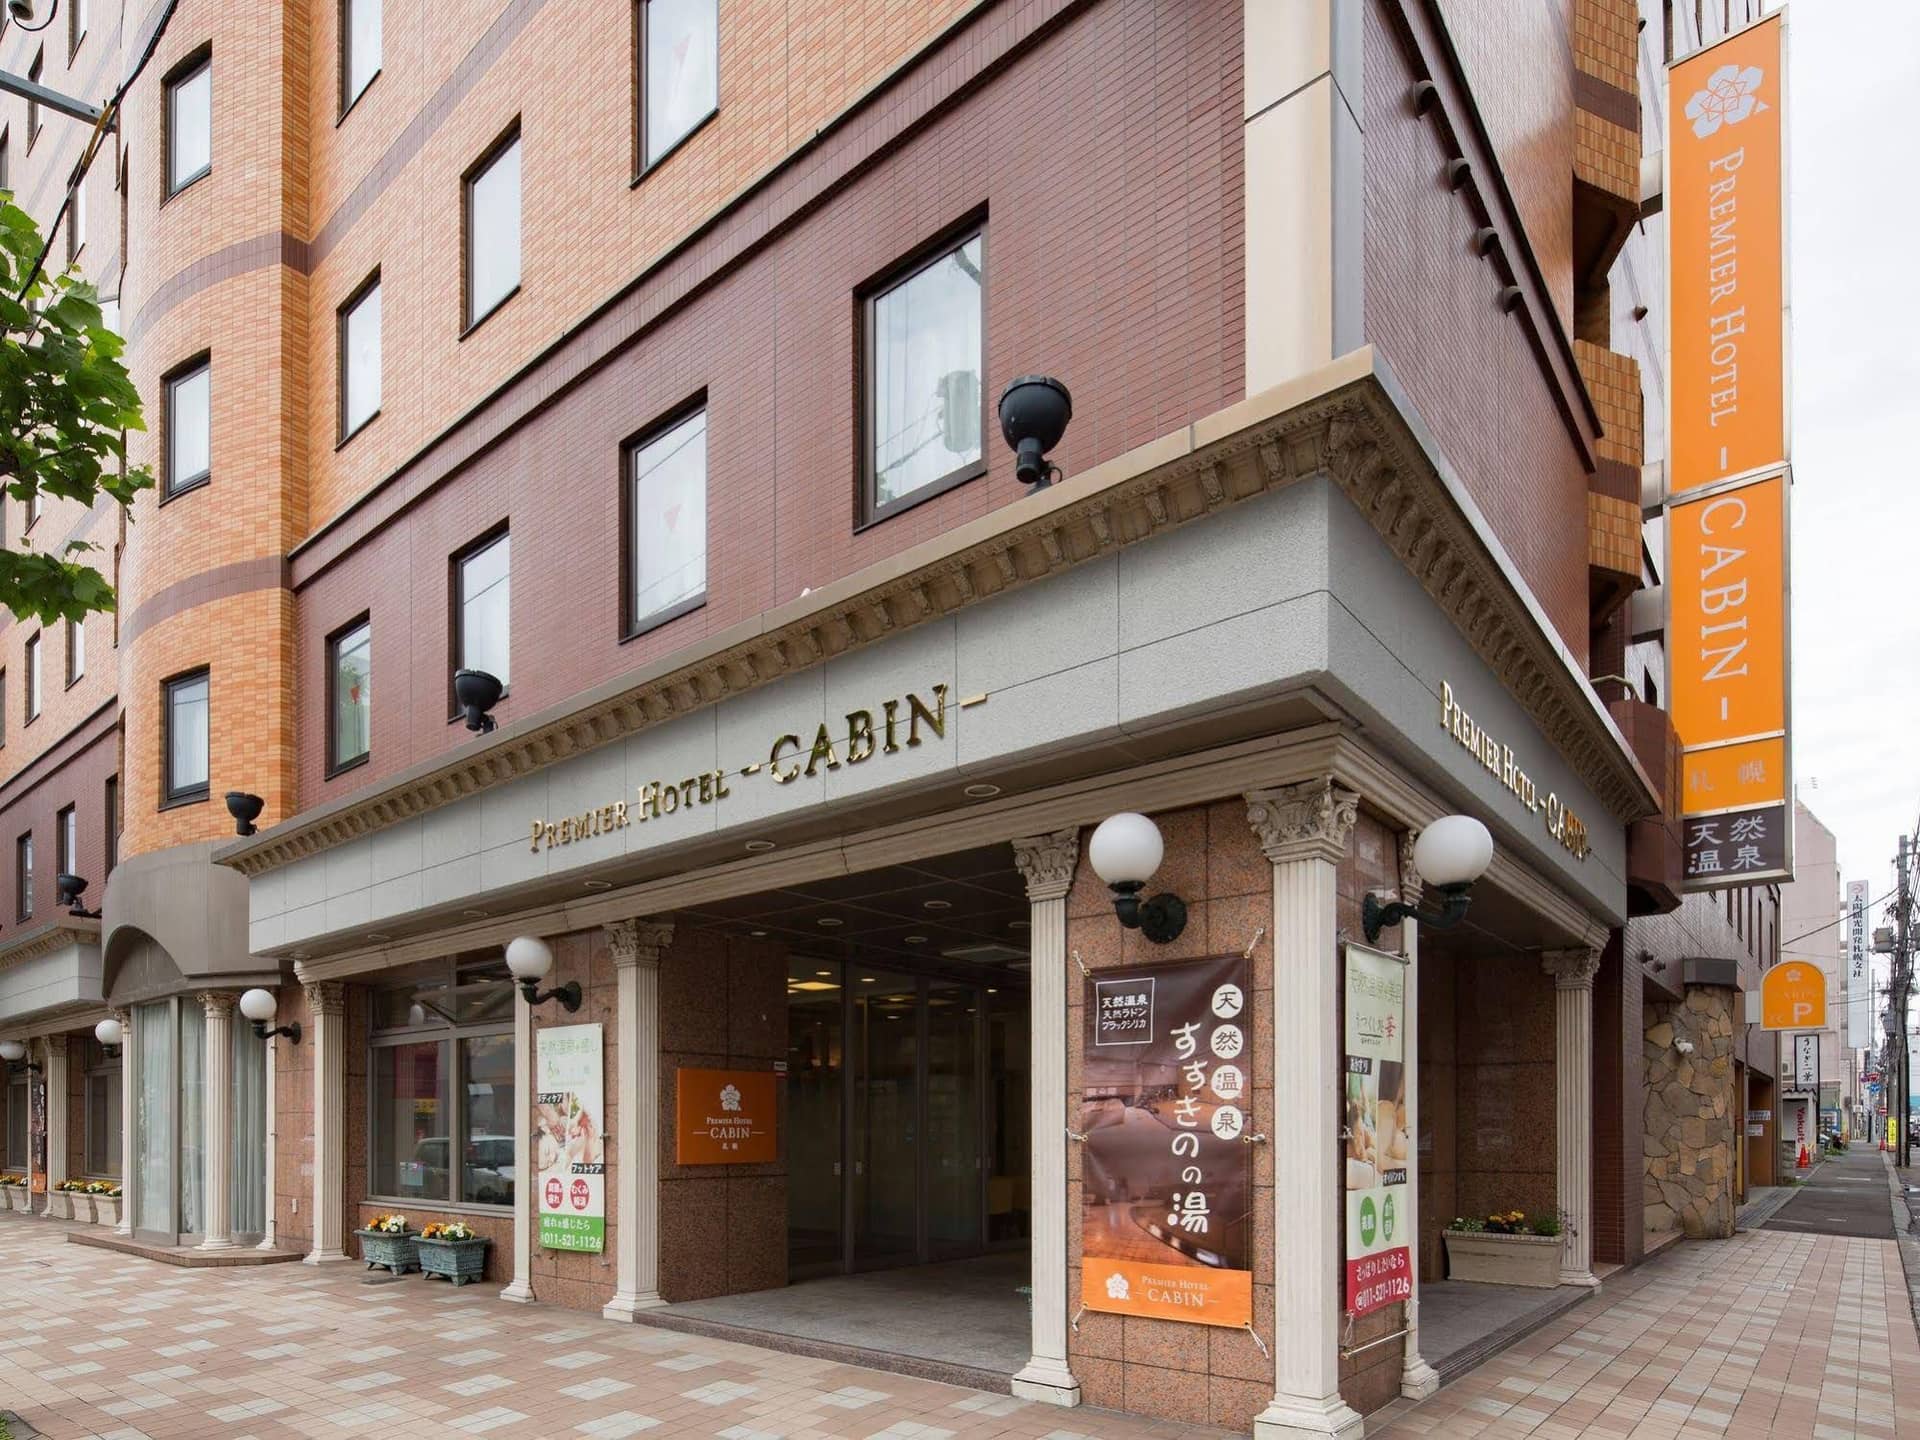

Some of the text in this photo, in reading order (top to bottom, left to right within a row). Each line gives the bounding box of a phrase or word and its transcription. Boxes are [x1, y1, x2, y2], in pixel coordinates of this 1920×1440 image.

[1709, 147, 1745, 427] PREMIER HOTEL
[1440, 680, 1501, 778] PREMIER
[530, 800, 629, 852] PREMIER
[638, 769, 730, 821] HOTEL
[1214, 987, 1241, 1136] 天然温泉
[1793, 1002, 1813, 1024] P
